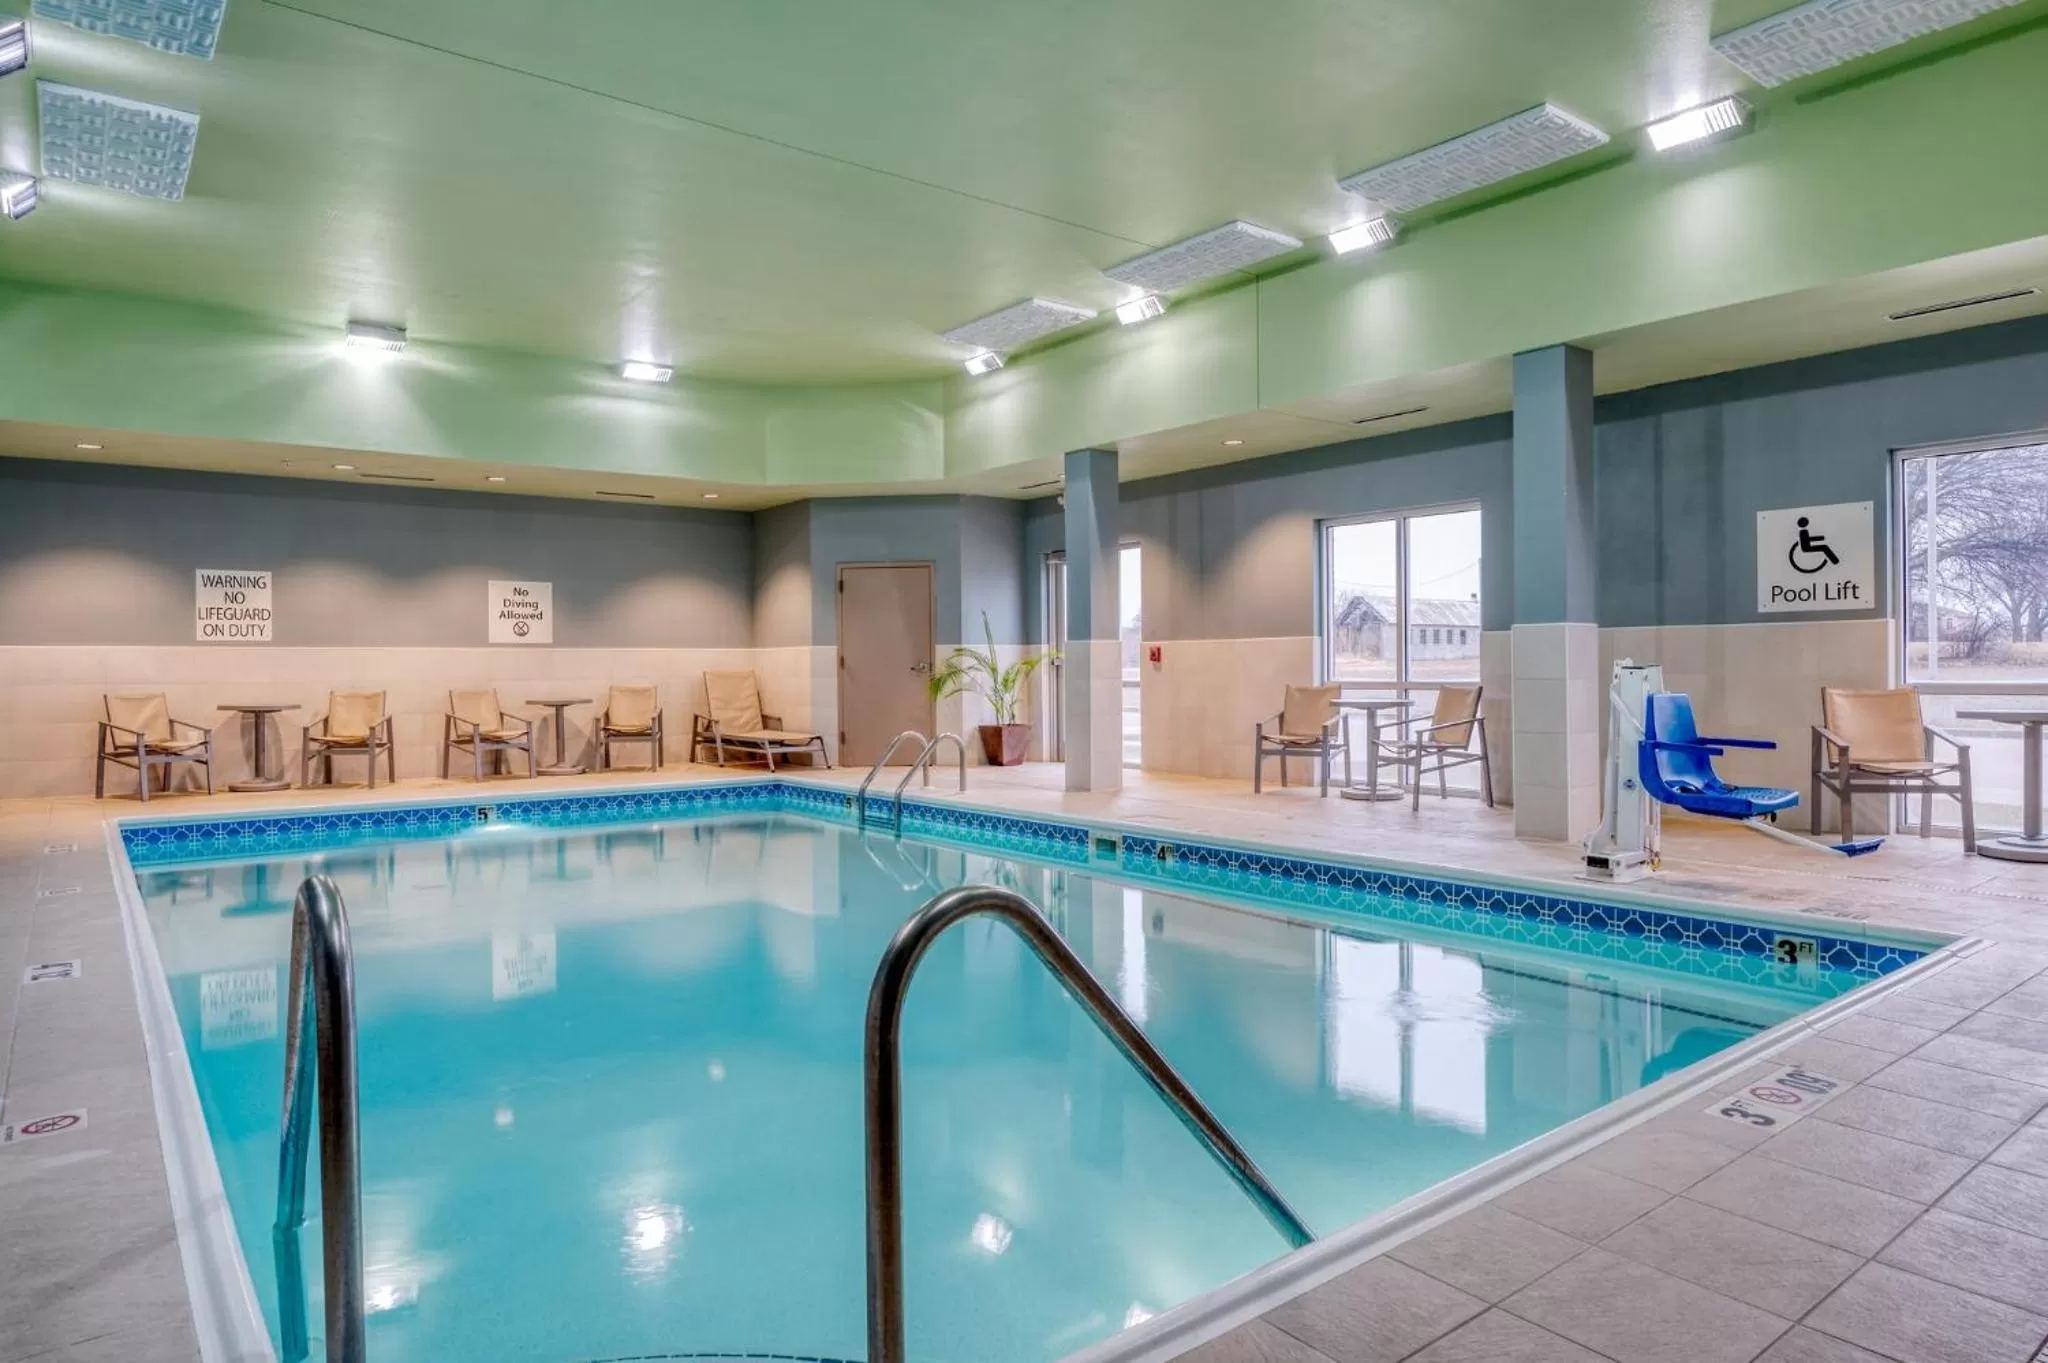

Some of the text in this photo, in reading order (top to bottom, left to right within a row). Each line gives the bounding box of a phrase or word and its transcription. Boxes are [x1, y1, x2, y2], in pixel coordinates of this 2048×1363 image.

[202, 574, 266, 589] WARNING
[224, 591, 245, 604] NO
[513, 587, 529, 596] No
[1772, 580, 1860, 603] Pool Lift
[503, 599, 538, 611] Diving
[198, 607, 271, 621] LIFEGUARD
[499, 610, 543, 620] Allowed
[203, 624, 265, 637] ON DUTY
